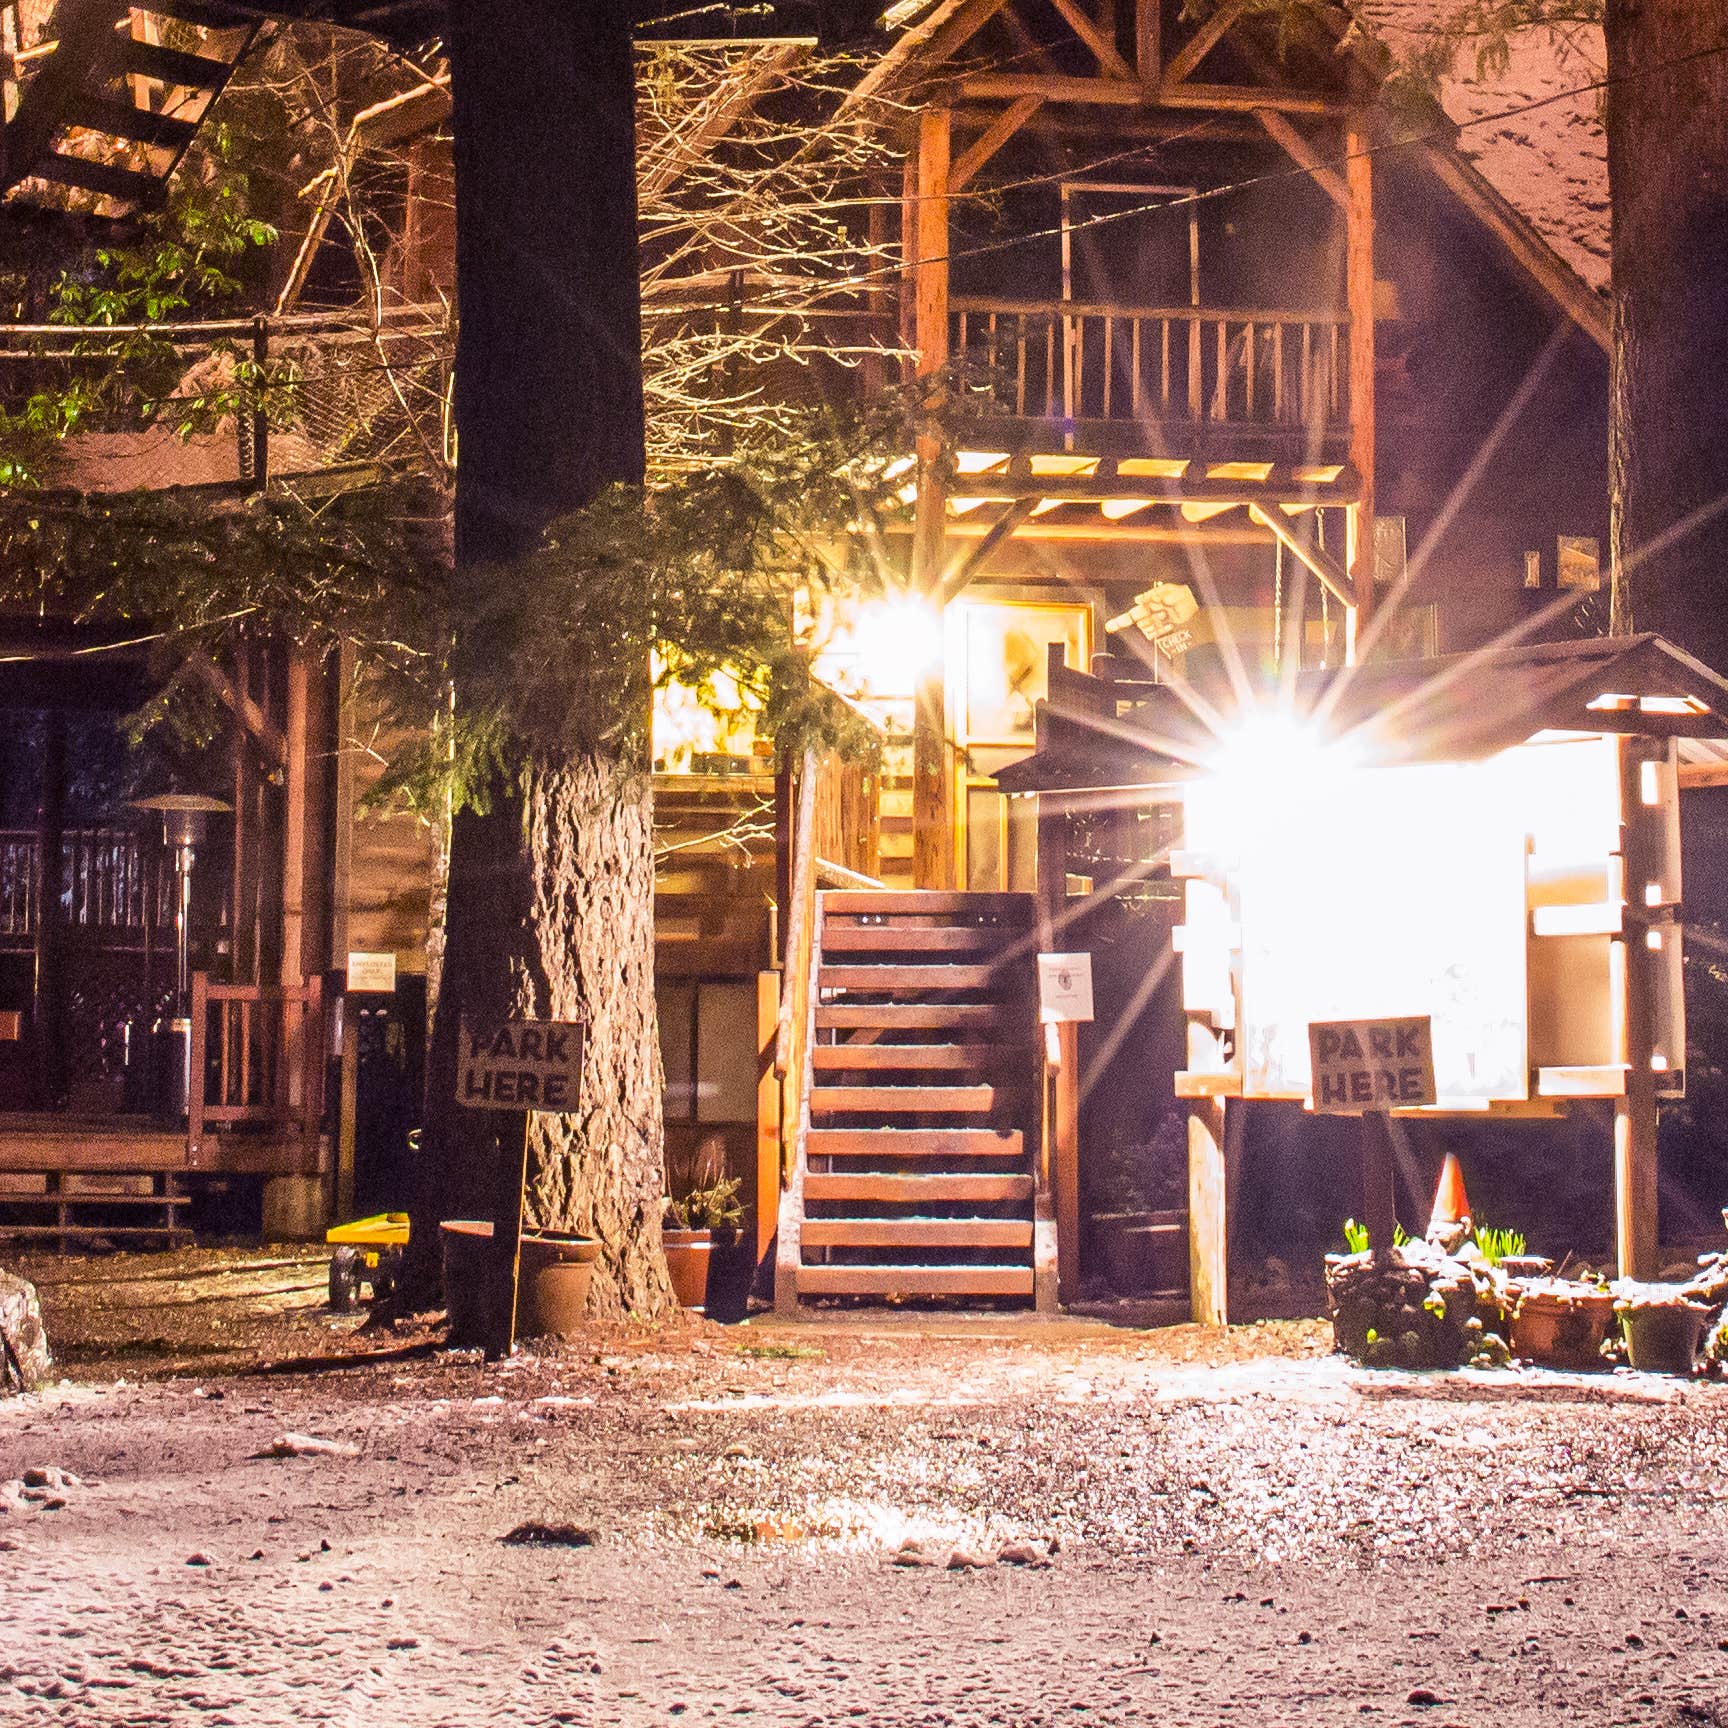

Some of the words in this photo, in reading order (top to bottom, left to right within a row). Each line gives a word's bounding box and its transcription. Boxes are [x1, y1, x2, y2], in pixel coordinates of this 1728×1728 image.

[471, 1027, 569, 1063] PARK
[1318, 1024, 1421, 1064] PARK
[465, 1069, 570, 1106] HERE
[1321, 1066, 1425, 1104] HERE
